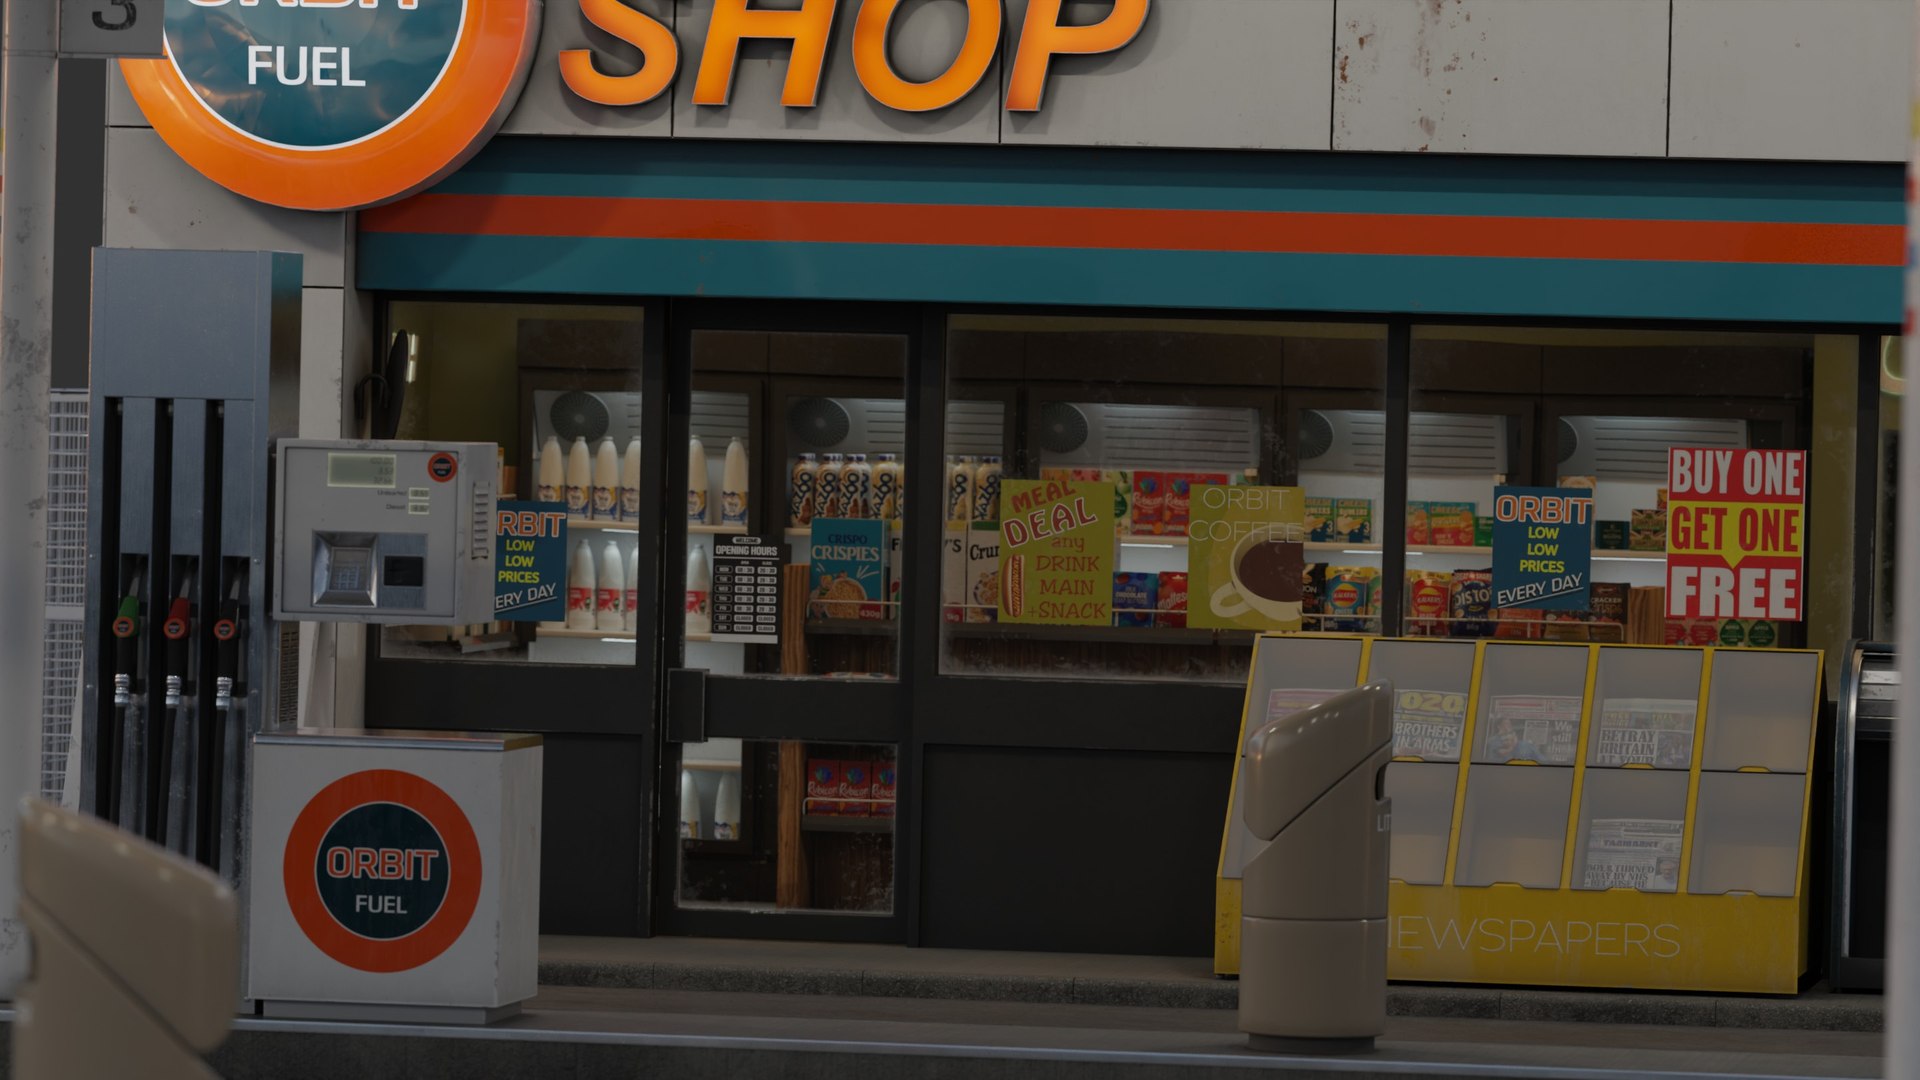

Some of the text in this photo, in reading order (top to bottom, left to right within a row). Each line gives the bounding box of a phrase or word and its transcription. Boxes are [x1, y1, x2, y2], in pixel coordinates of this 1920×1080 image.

[559, 0, 1150, 112] SHOP
[247, 45, 366, 87] FUEL
[1671, 449, 1802, 496] BUY ONE
[1011, 481, 1077, 513] MEAL
[1203, 487, 1291, 510] ORBIT
[1496, 495, 1592, 525] ORBIT
[497, 511, 566, 538] RBIT
[1003, 496, 1099, 549] DEAL
[1188, 520, 1302, 543] COFFEE
[1671, 505, 1728, 551] GET
[1738, 507, 1800, 553] ONE
[828, 534, 868, 544] CRISPO
[1528, 526, 1559, 540] LOW
[505, 539, 535, 552] LOW
[715, 545, 777, 556] OPENING HOURS
[812, 545, 880, 562] CRISPIES
[1051, 537, 1085, 553] any
[1527, 543, 1559, 557] LOW
[505, 555, 535, 568] LOW
[1036, 555, 1100, 572] DRINK
[1519, 559, 1565, 573] PRICES
[498, 570, 540, 584] PRICES
[496, 590, 523, 609] ERY
[527, 582, 556, 602] DAY
[1040, 579, 1095, 595] MAIN
[1497, 572, 1582, 605] EVERY DAY
[1670, 565, 1797, 620] FREE
[1394, 722, 1458, 738] BROTHERS
[1602, 729, 1656, 742] BETRAY
[1395, 736, 1451, 752] IN ARMS
[1600, 742, 1655, 755] BRITAIN
[326, 846, 440, 881] ORBIT
[355, 894, 408, 914] FUEL
[1388, 915, 1680, 958] EWSPAPERS
